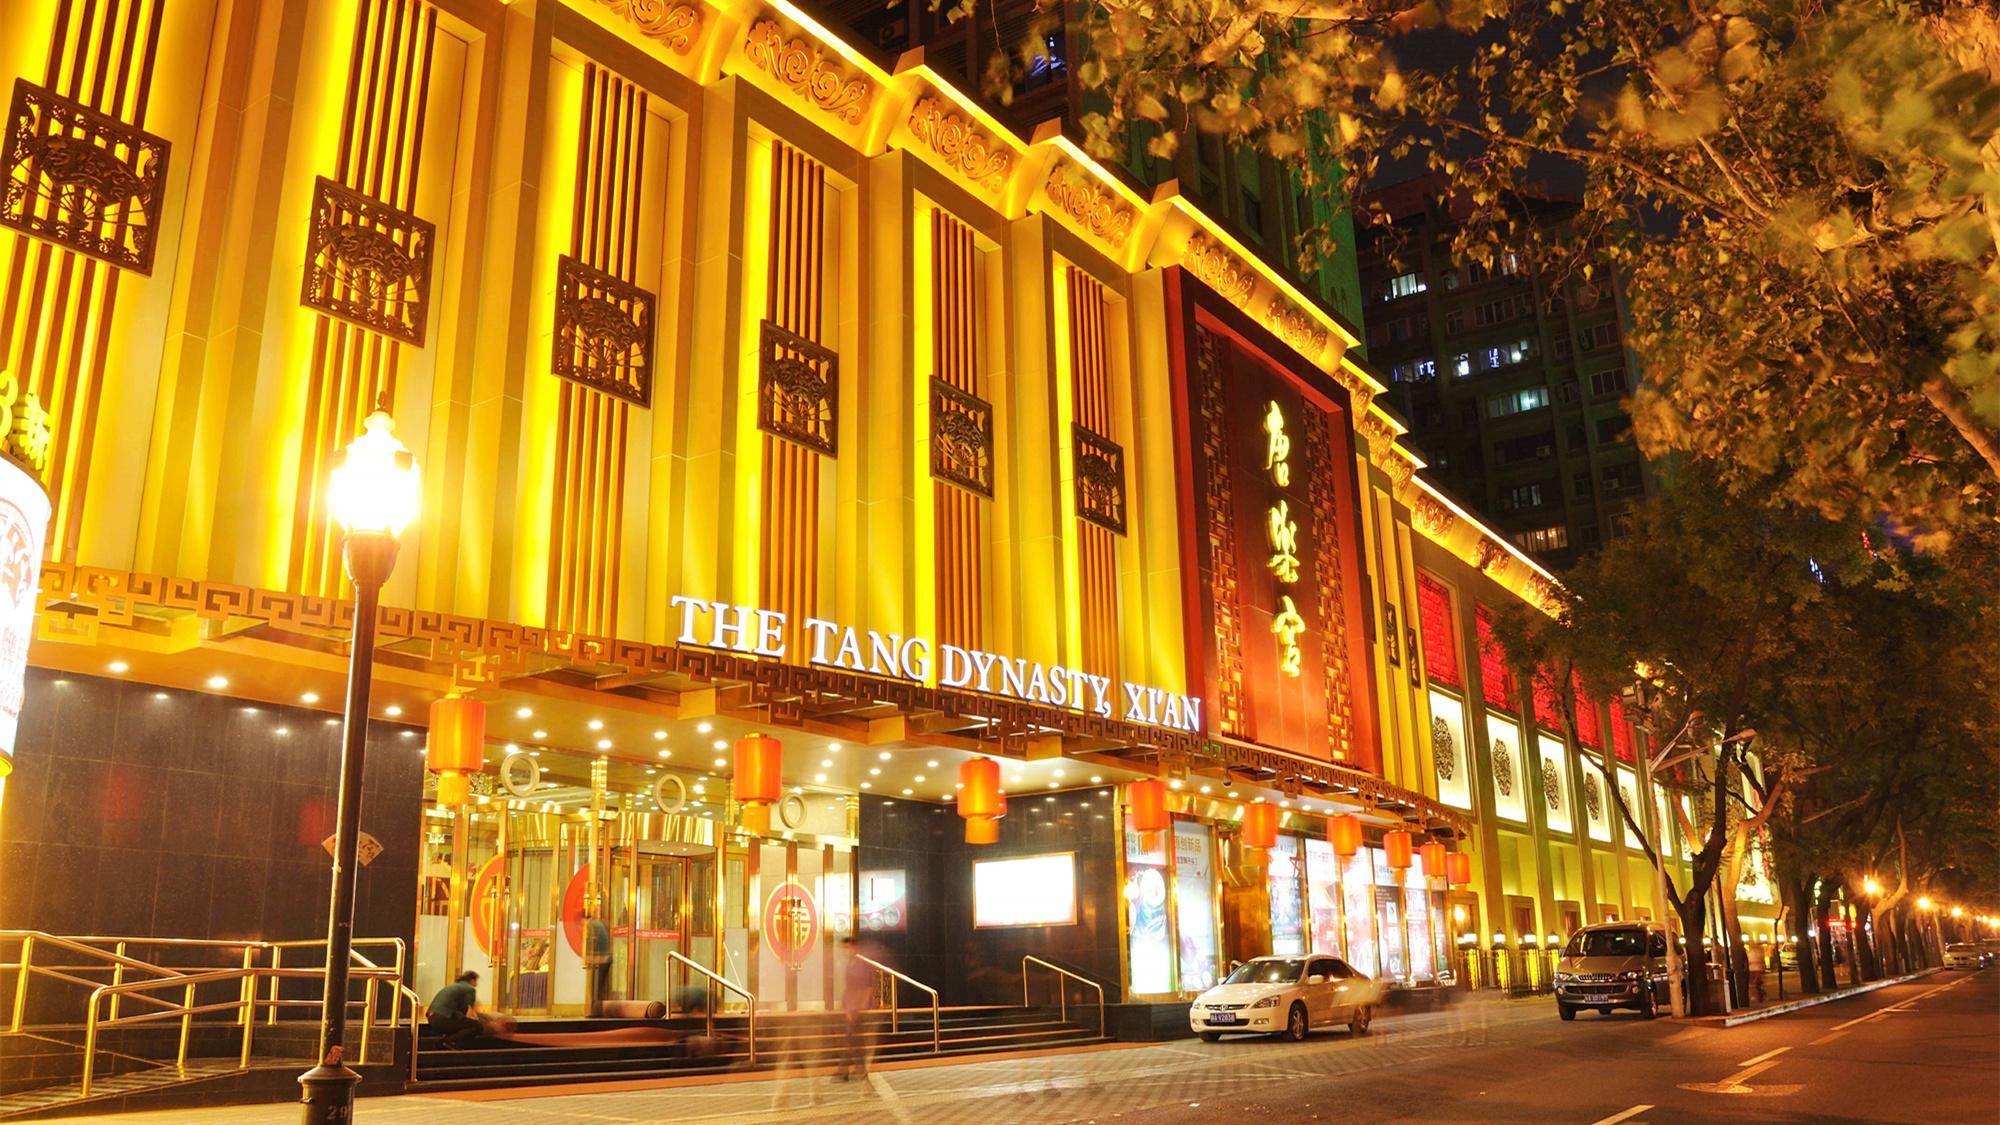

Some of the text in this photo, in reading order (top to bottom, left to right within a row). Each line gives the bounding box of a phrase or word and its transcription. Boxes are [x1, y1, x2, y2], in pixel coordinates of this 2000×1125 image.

[671, 595, 1201, 732] THE TANG DYNASTY, XI'AN
